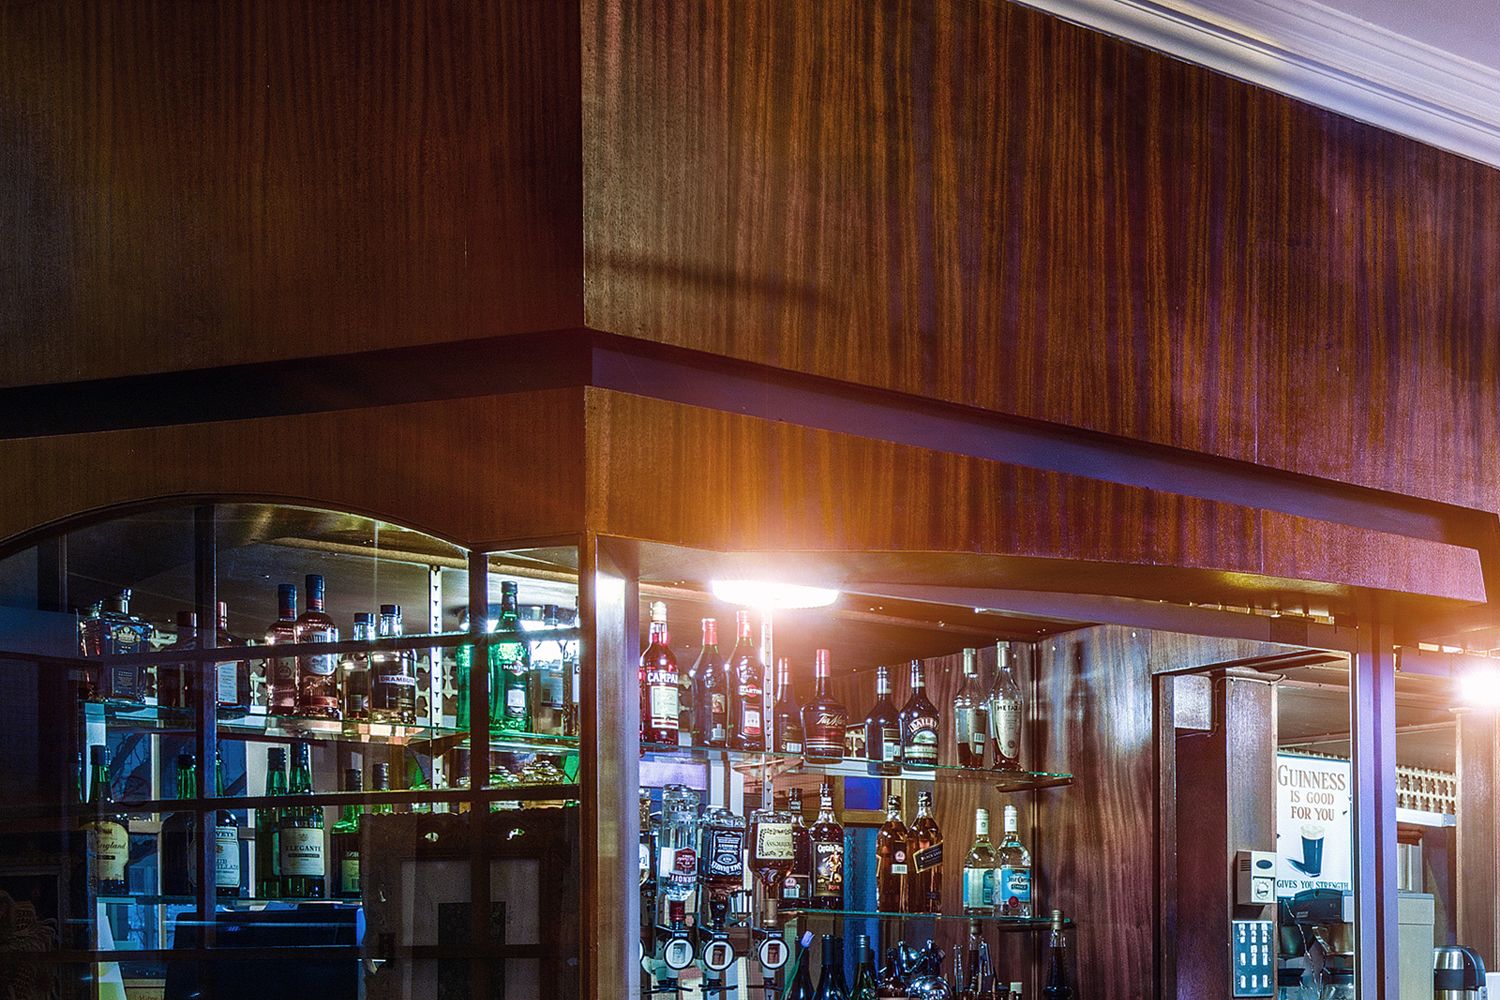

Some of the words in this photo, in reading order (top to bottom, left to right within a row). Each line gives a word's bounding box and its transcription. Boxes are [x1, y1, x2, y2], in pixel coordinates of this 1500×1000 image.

[1278, 764, 1346, 791] GUINNESS
[1290, 790, 1301, 803] IS
[1306, 792, 1335, 805] GOOD
[1291, 806, 1311, 820] FOR
[1314, 807, 1335, 821] YOU
[1276, 880, 1298, 888] GIVES
[1300, 880, 1314, 889] YOU
